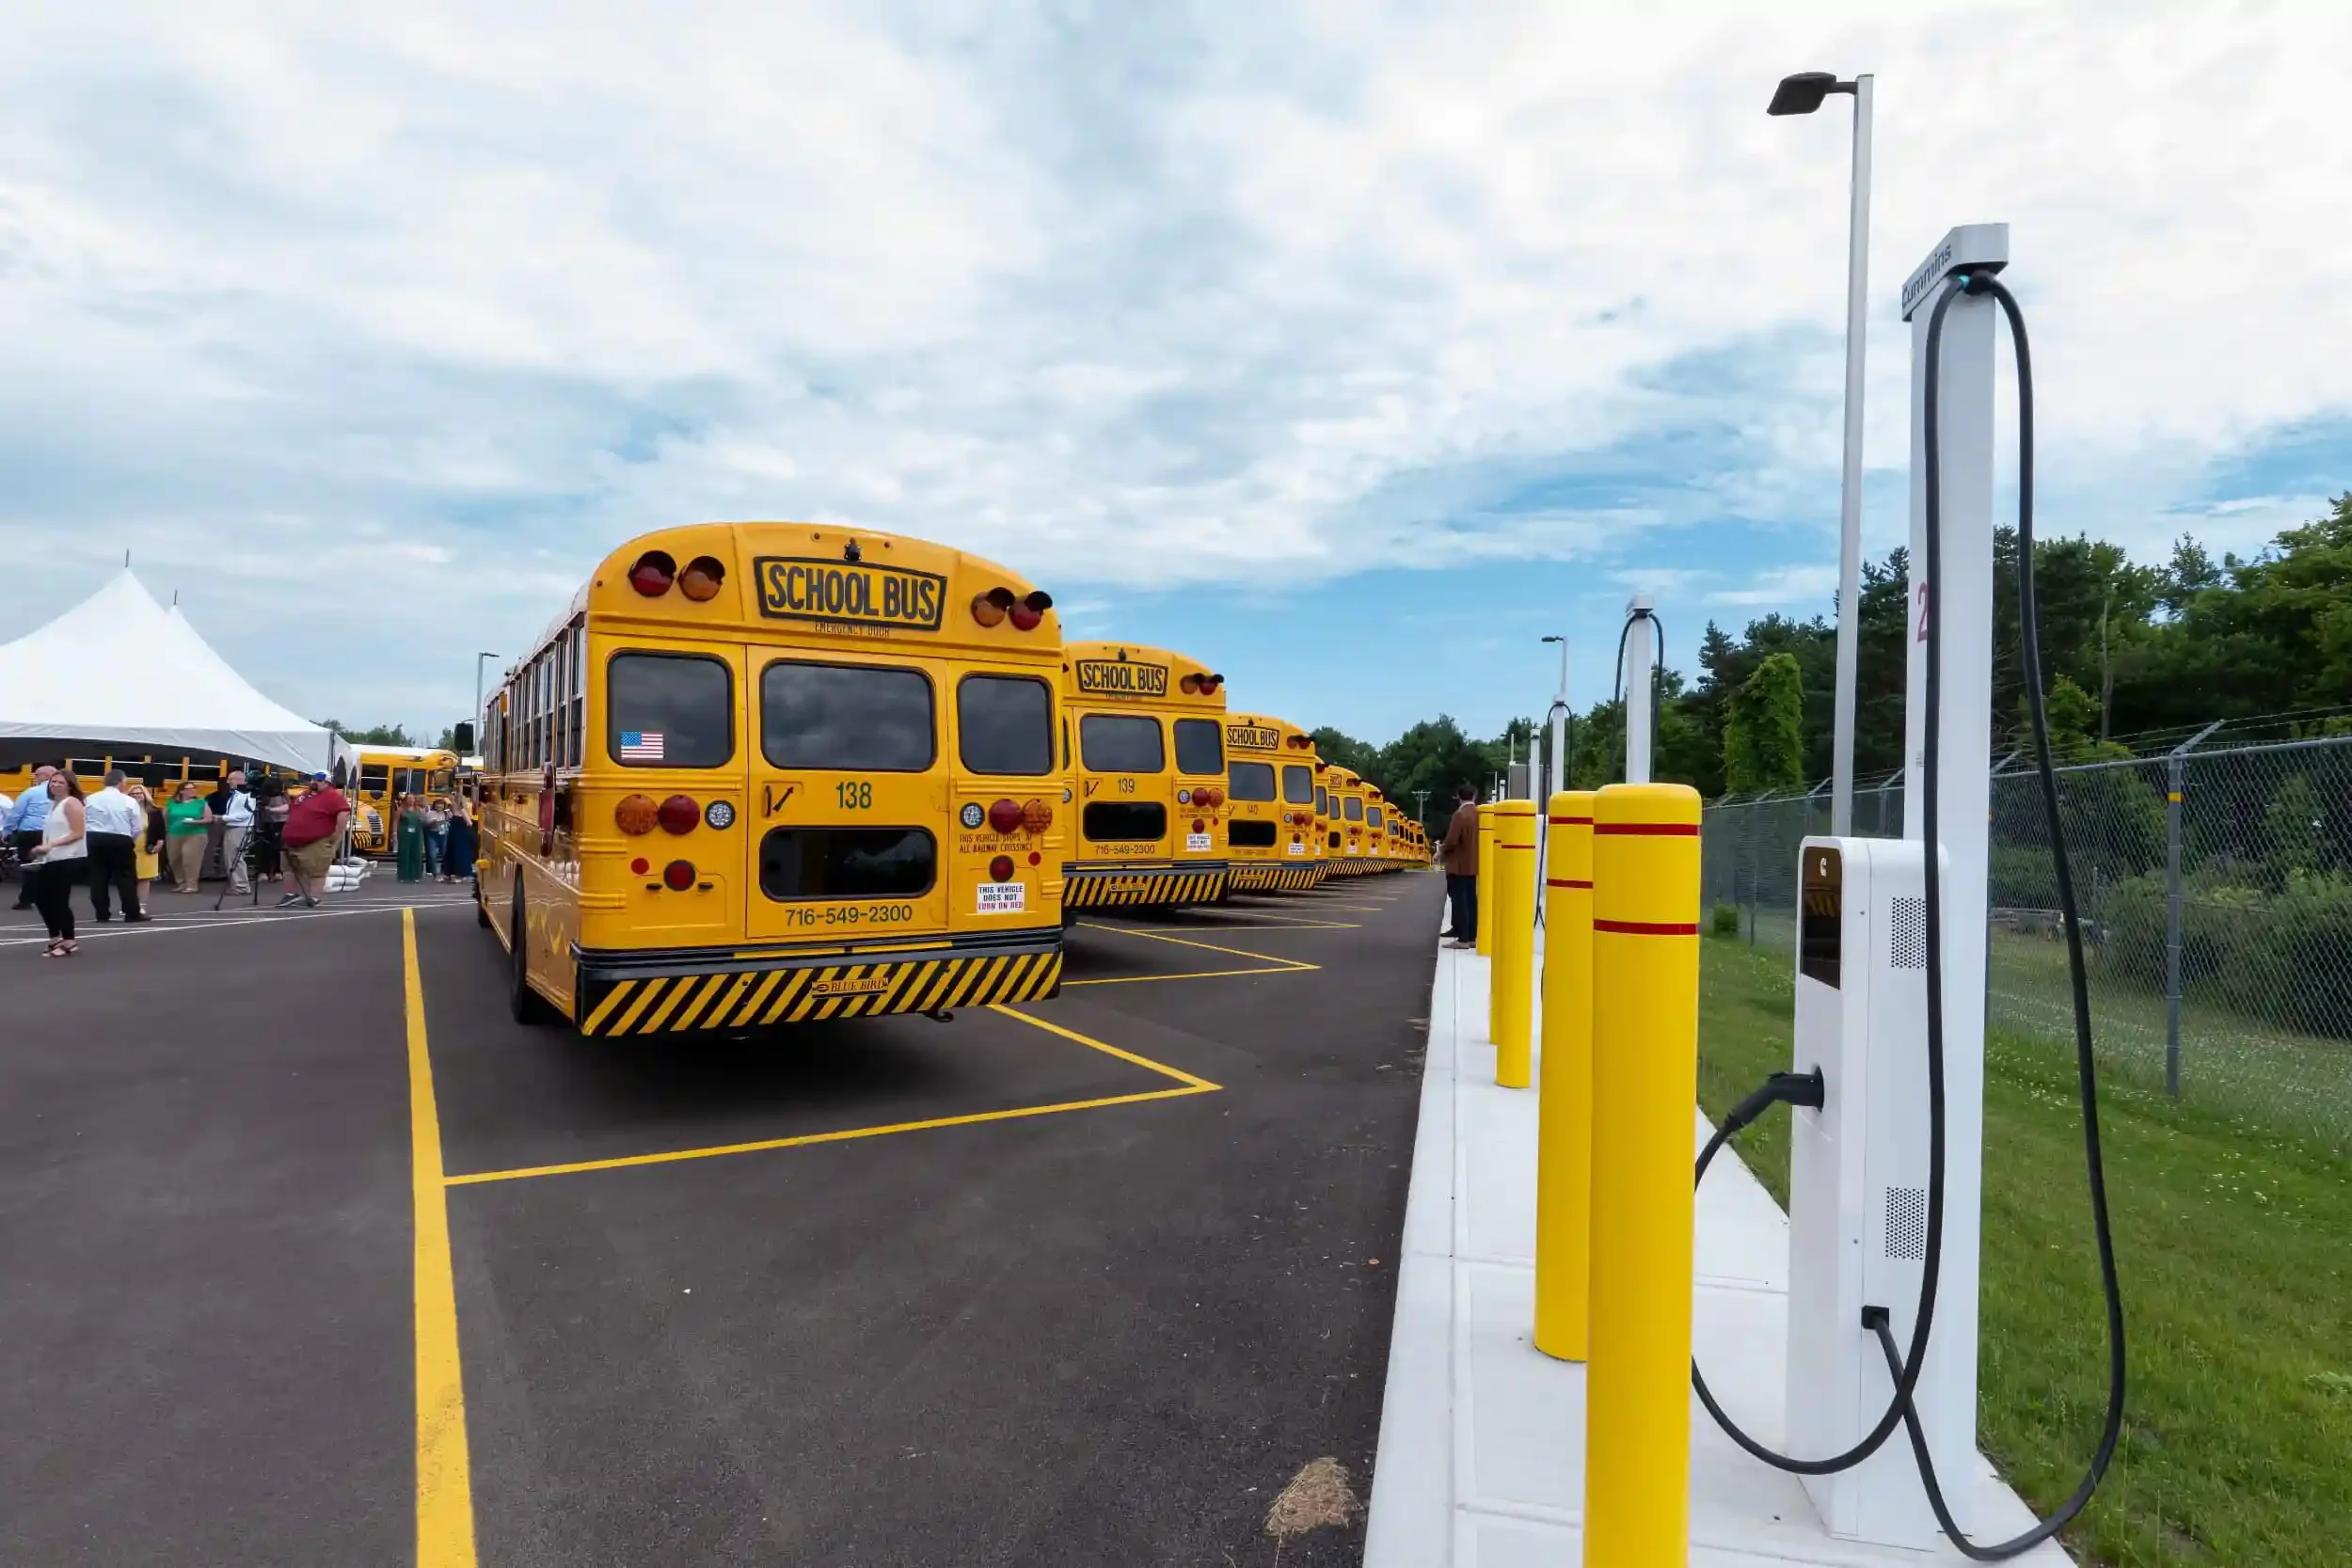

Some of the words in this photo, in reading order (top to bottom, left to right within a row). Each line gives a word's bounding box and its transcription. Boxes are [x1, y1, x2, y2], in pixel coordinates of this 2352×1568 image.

[1902, 244, 1952, 309] Cummins
[768, 563, 880, 616] SCHOOL
[883, 576, 937, 621] BUS
[1916, 581, 1929, 643] 2
[1083, 664, 1136, 689] SCHOOL
[1137, 667, 1163, 691] BUS
[1227, 728, 1260, 745] SCHOOL
[1261, 731, 1277, 746] BUS
[835, 781, 872, 810] 138
[1118, 778, 1135, 793] 139
[997, 885, 1024, 894] VEHICLE
[786, 905, 913, 927] 716-549-2300
[978, 902, 995, 911] TURN
